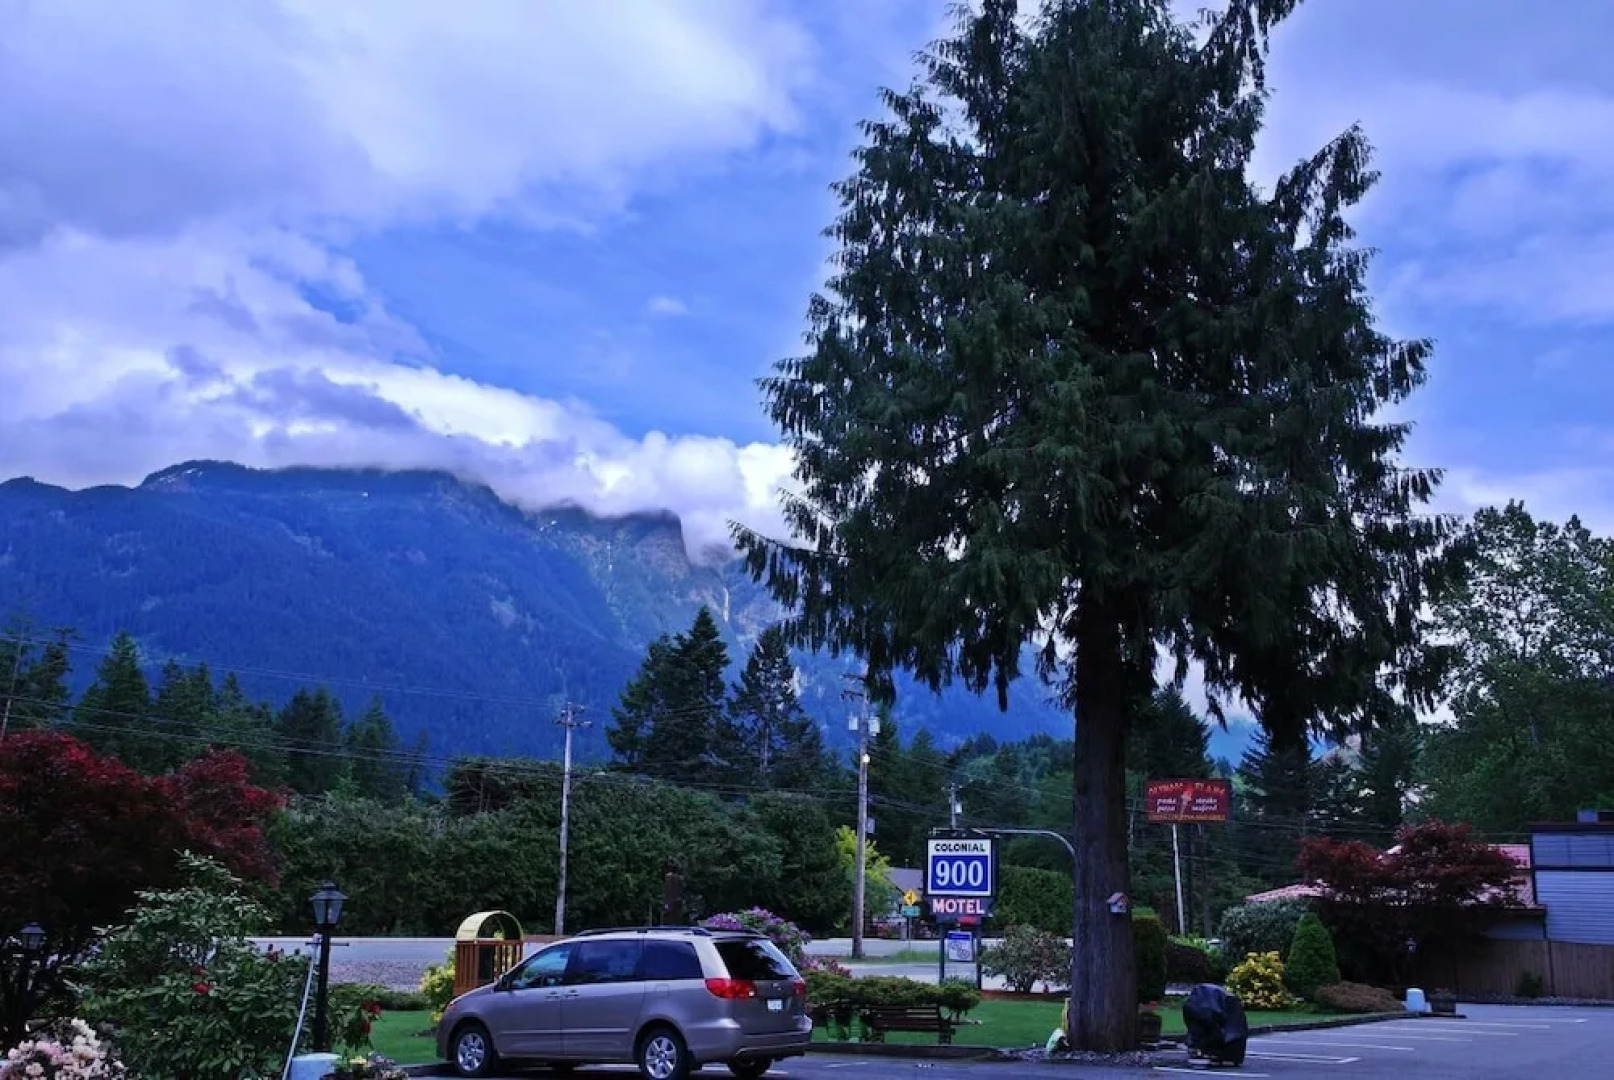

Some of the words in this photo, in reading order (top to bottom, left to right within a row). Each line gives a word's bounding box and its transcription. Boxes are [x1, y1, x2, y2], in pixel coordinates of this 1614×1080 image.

[934, 843, 985, 852] COLONIAL
[935, 860, 983, 887] 900
[932, 898, 985, 914] MOTEL
